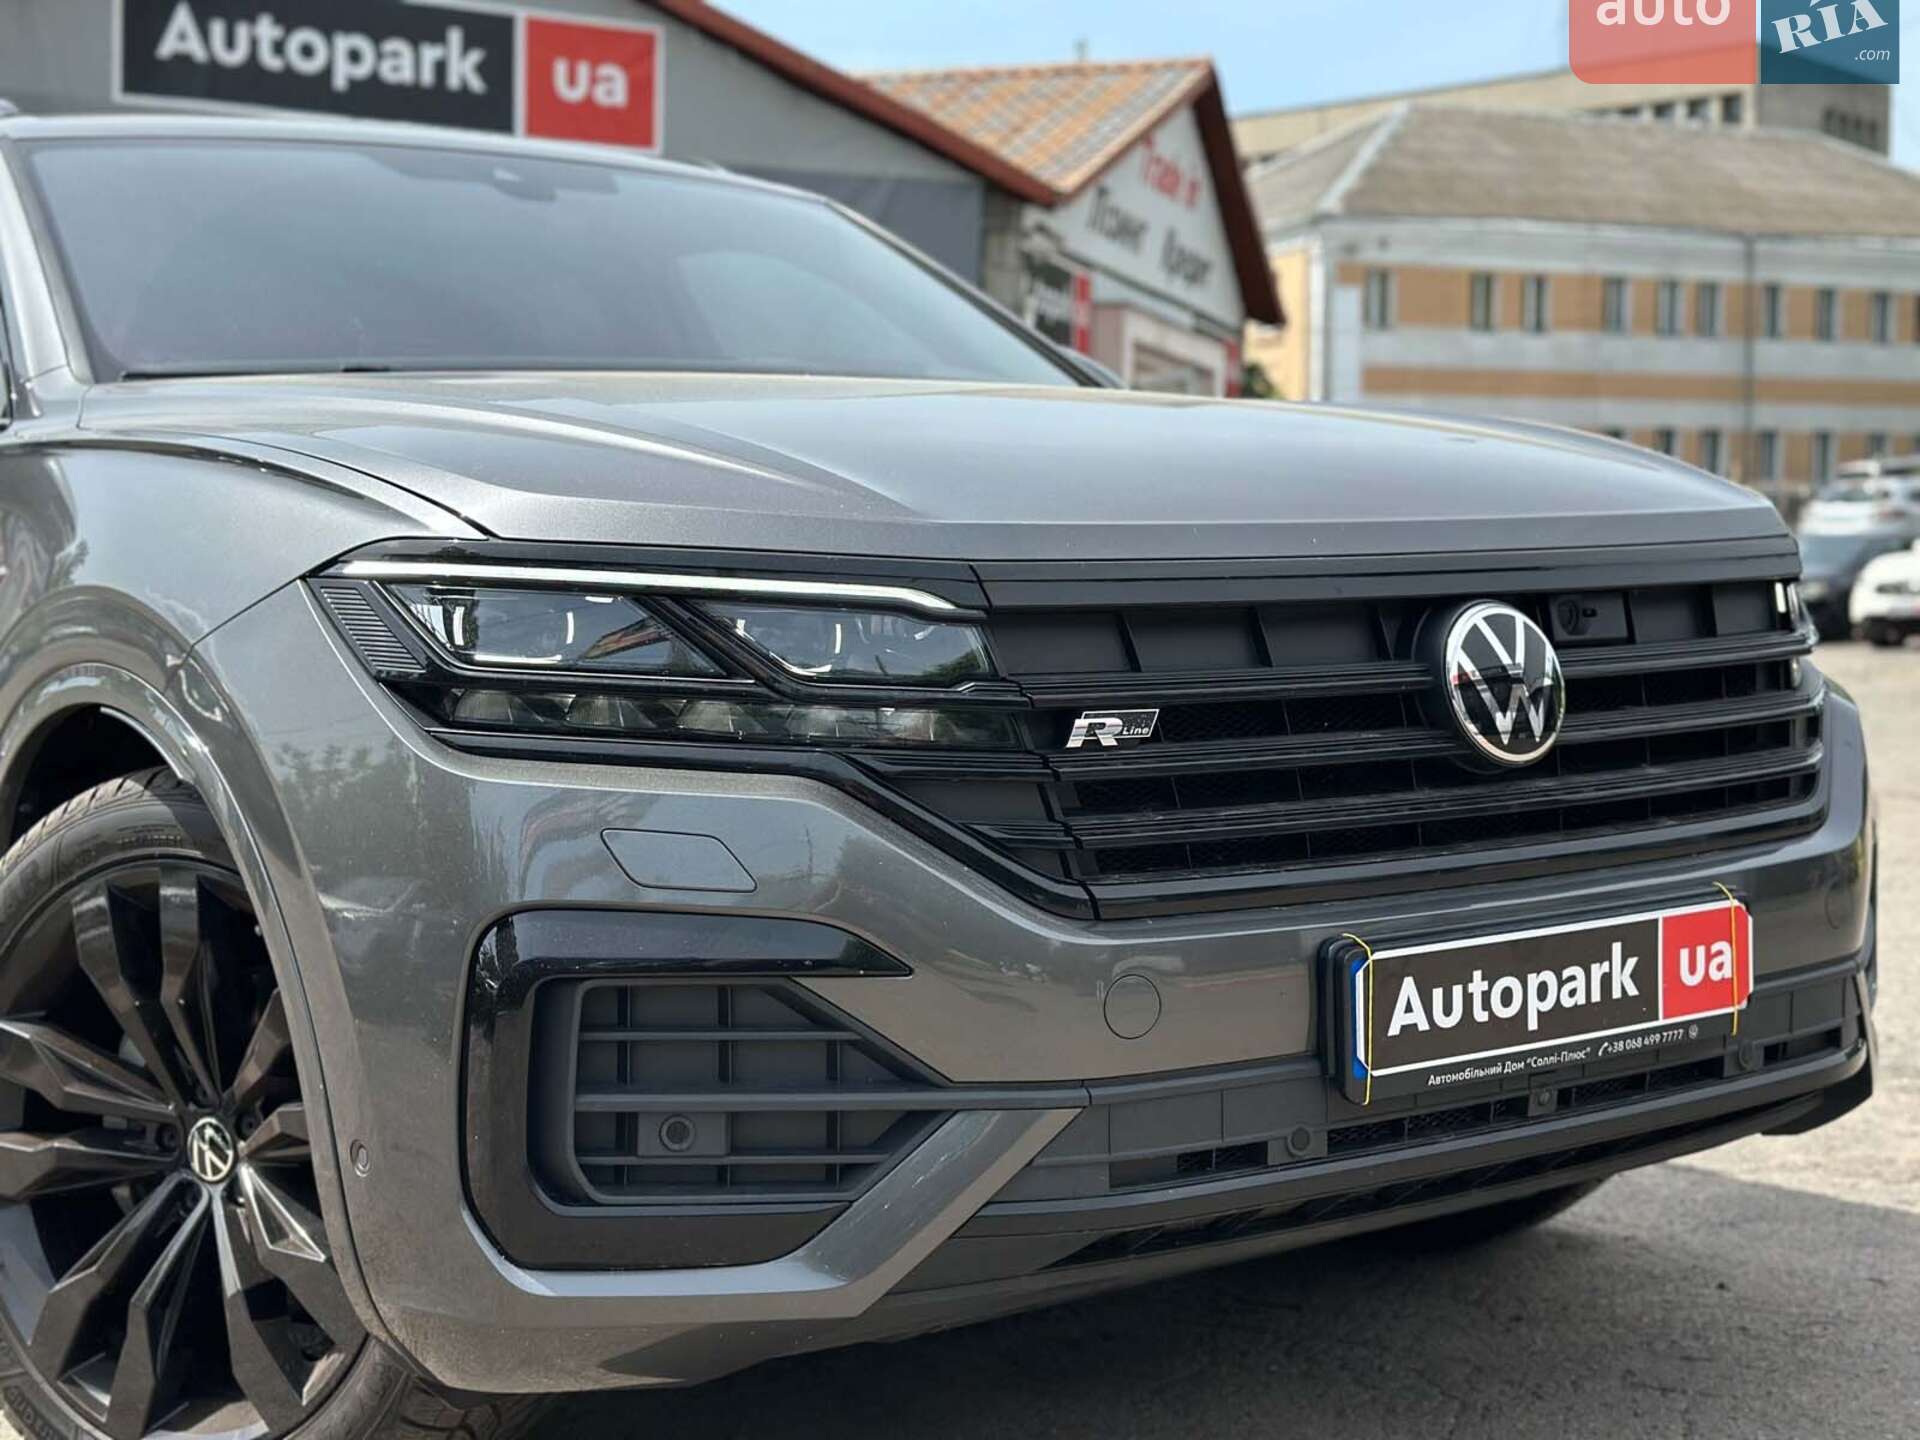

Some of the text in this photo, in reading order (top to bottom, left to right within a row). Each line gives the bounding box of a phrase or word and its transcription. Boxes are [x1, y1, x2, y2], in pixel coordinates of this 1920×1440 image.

[156, 2, 629, 109] Autopark ua
[1387, 940, 1734, 1036] Autopark ua
[1428, 1063, 1502, 1086] Автомобільний
[1503, 1060, 1525, 1074] Дом
[1607, 1040, 1624, 1053] +38
[1662, 1029, 1684, 1043] 7777
